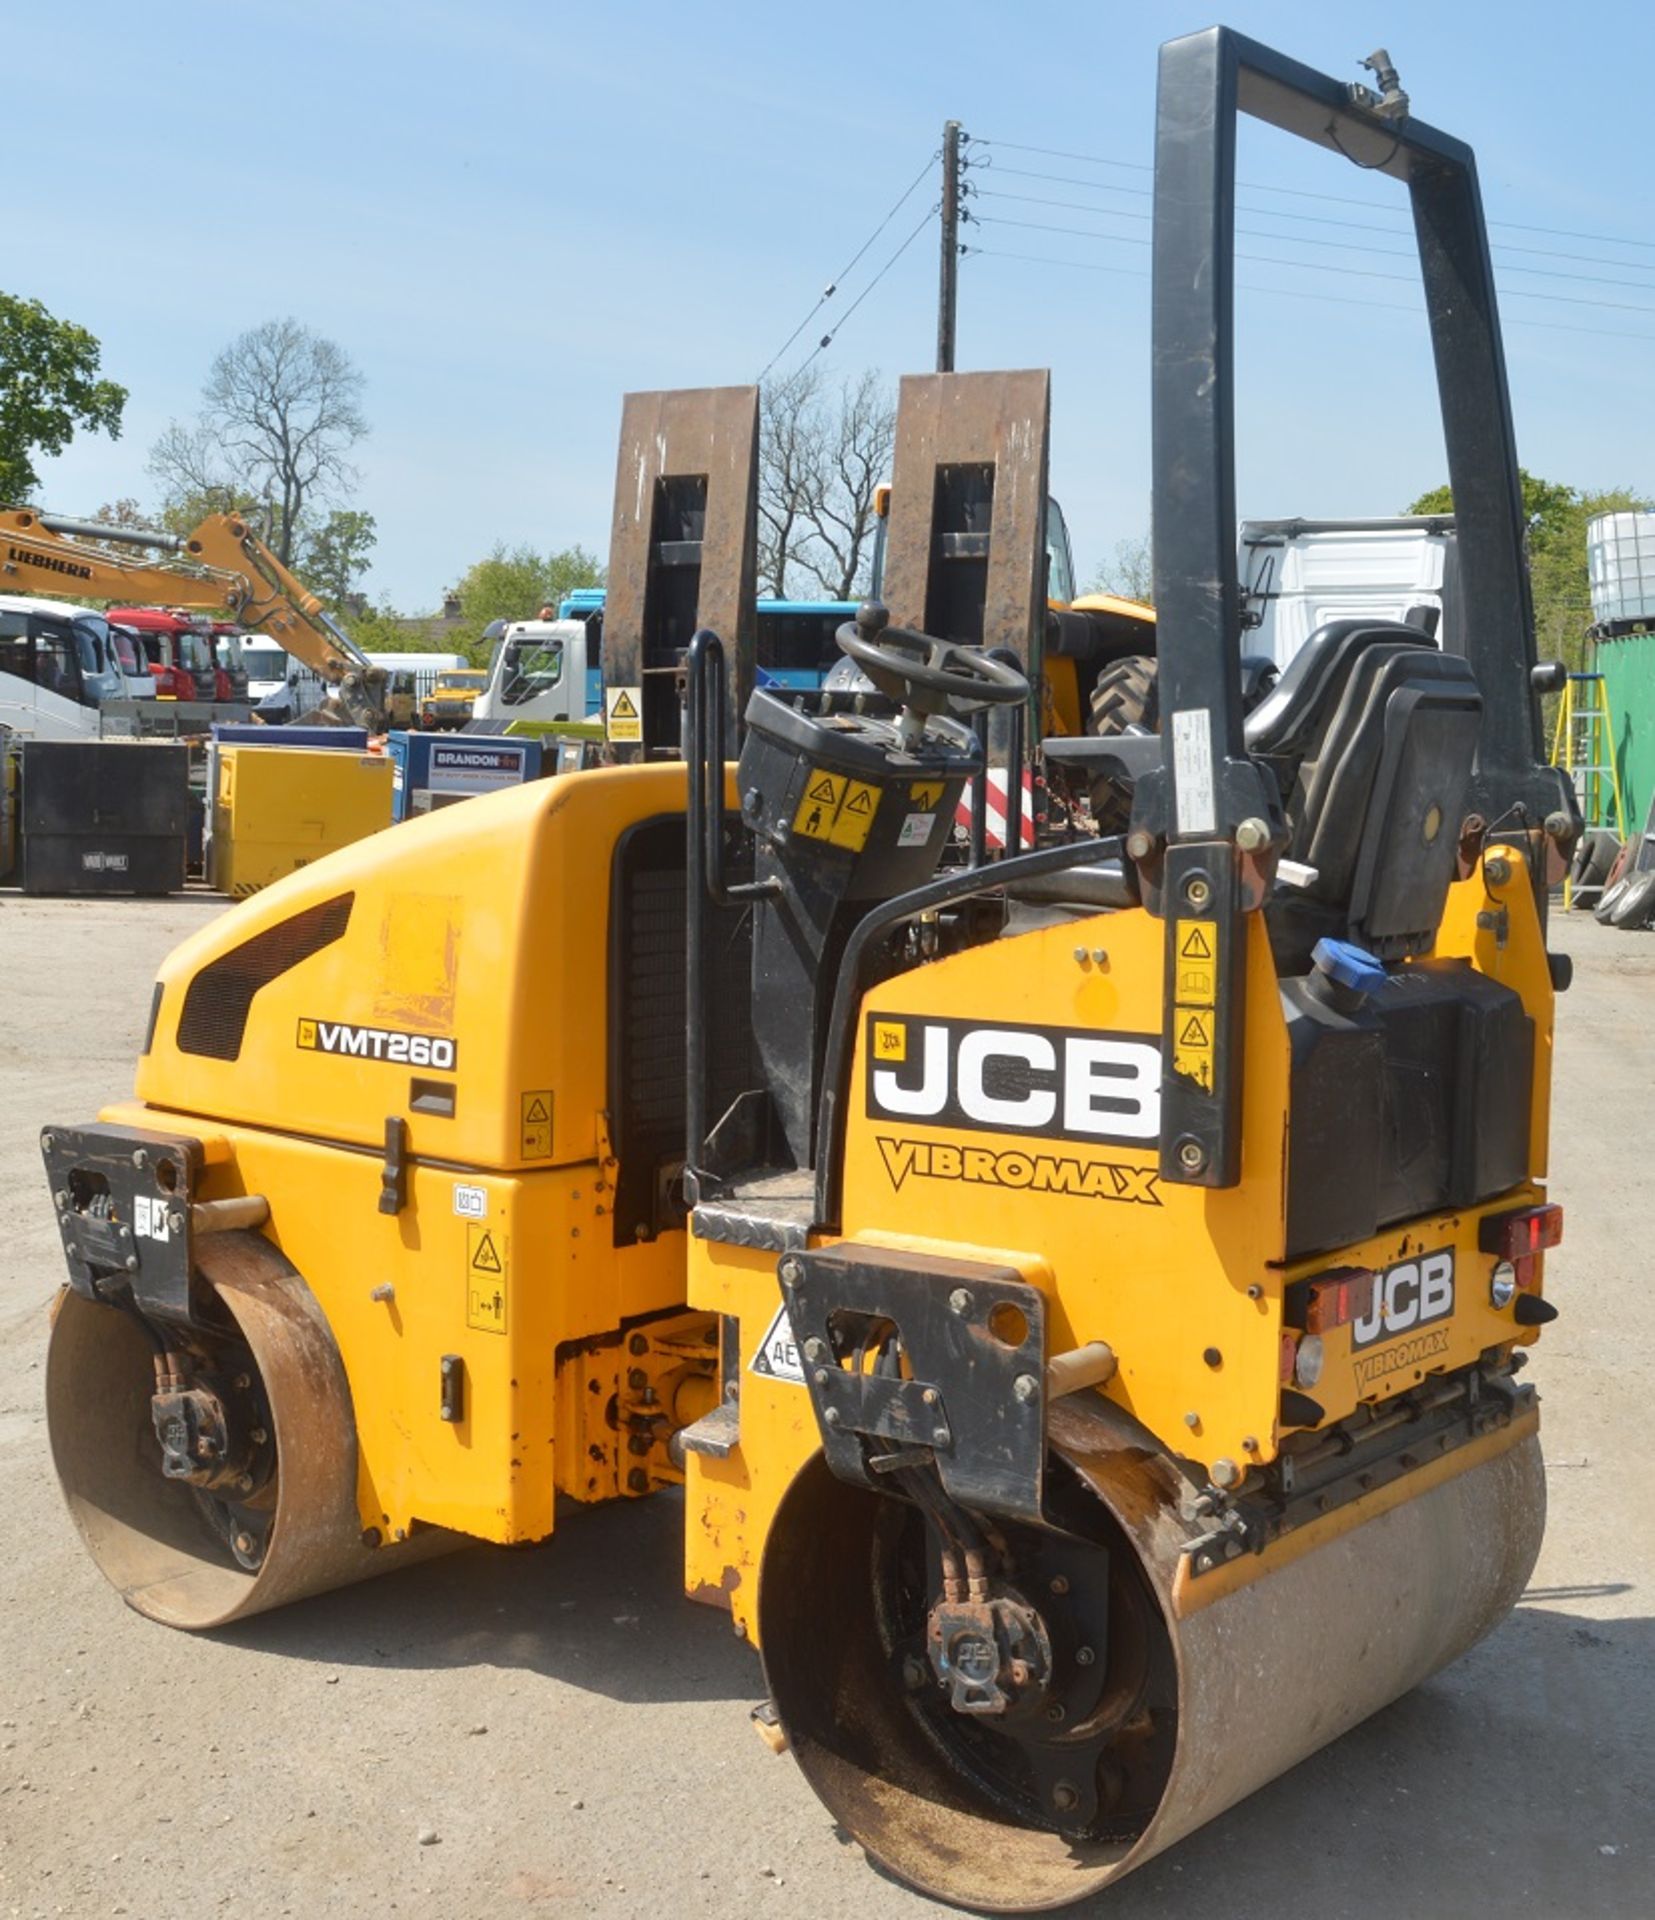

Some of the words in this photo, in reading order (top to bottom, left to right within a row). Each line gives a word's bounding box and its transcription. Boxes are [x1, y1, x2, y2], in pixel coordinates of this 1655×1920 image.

[9, 547, 91, 579] LIEBHERR
[318, 1022, 453, 1068] VMT260
[873, 1025, 1162, 1138] JCB
[875, 1136, 1163, 1207] VIBROMAX
[1354, 1253, 1452, 1343] JCB
[1353, 1327, 1449, 1398] VIBROMAX
